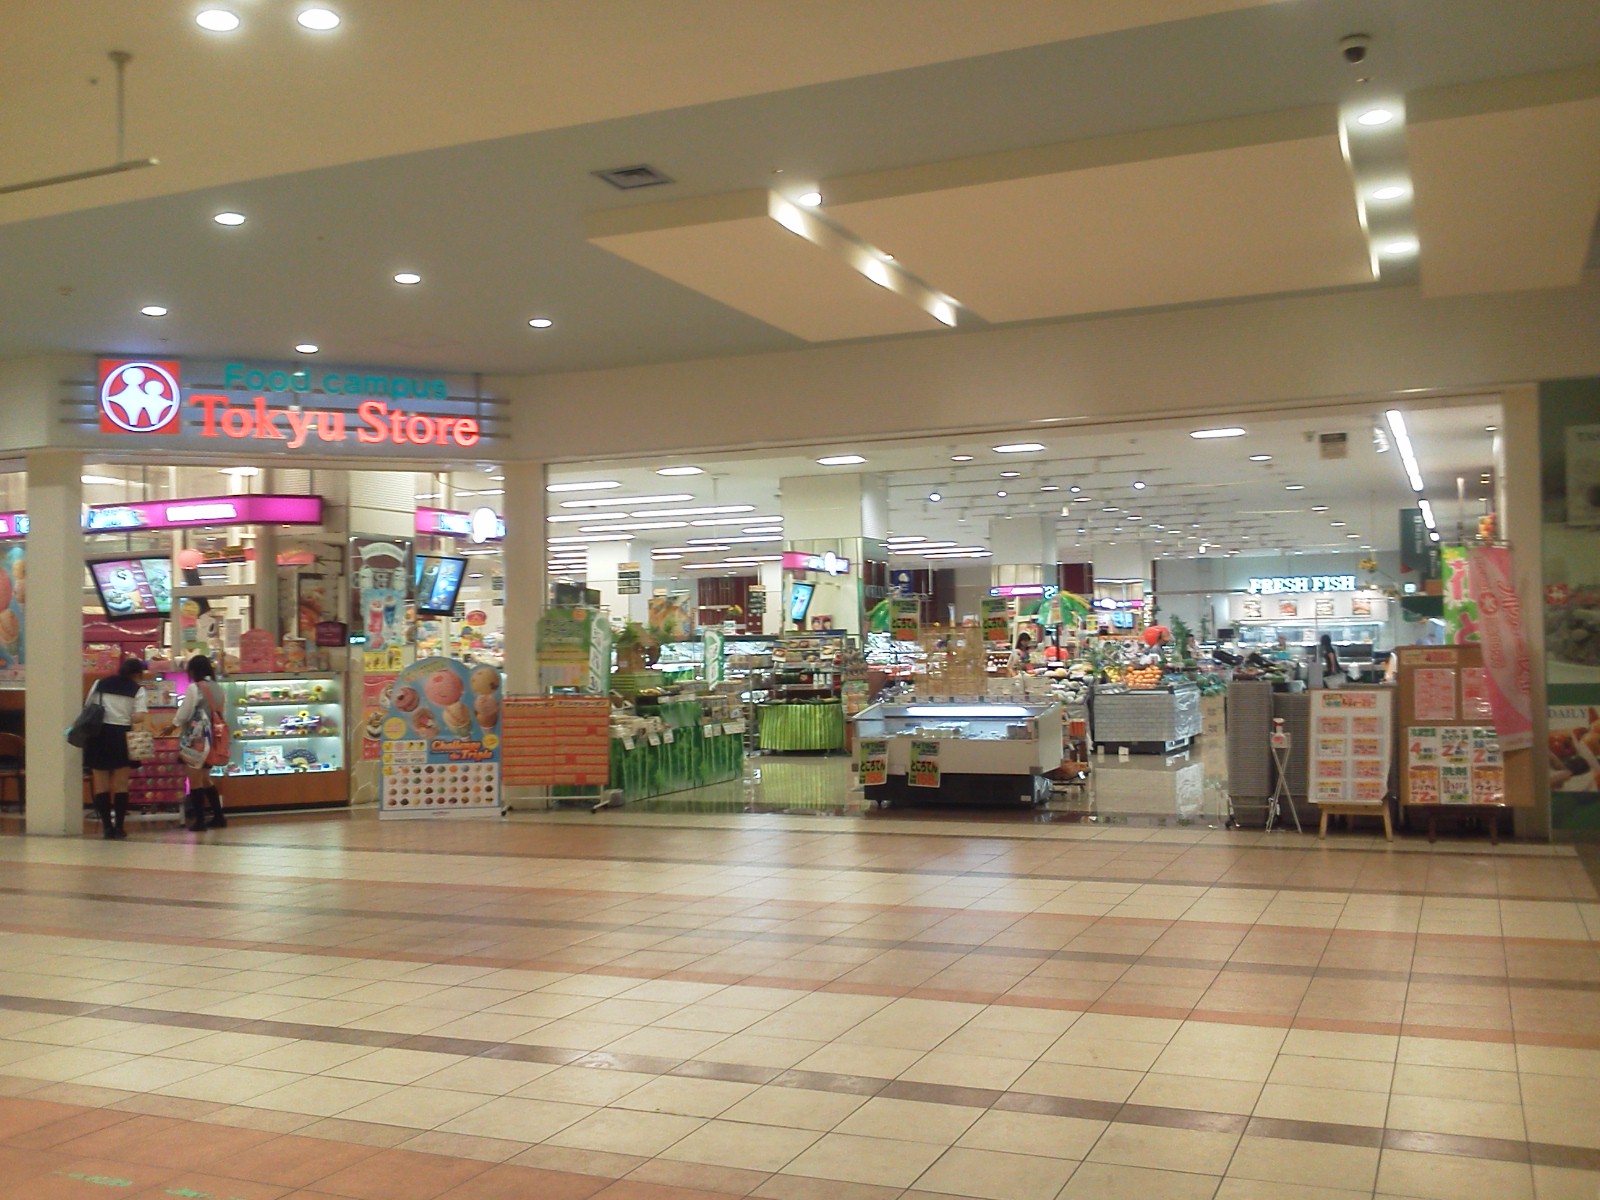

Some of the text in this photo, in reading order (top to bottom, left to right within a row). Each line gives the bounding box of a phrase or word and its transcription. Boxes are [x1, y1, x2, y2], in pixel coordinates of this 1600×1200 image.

[223, 364, 448, 400] Food campus
[189, 394, 481, 449] Tokyu Store
[1248, 574, 1357, 595] FRESH FISH
[1548, 707, 1587, 719] DAILY
[860, 759, 886, 773] ところてん
[910, 759, 938, 773] ところてん
